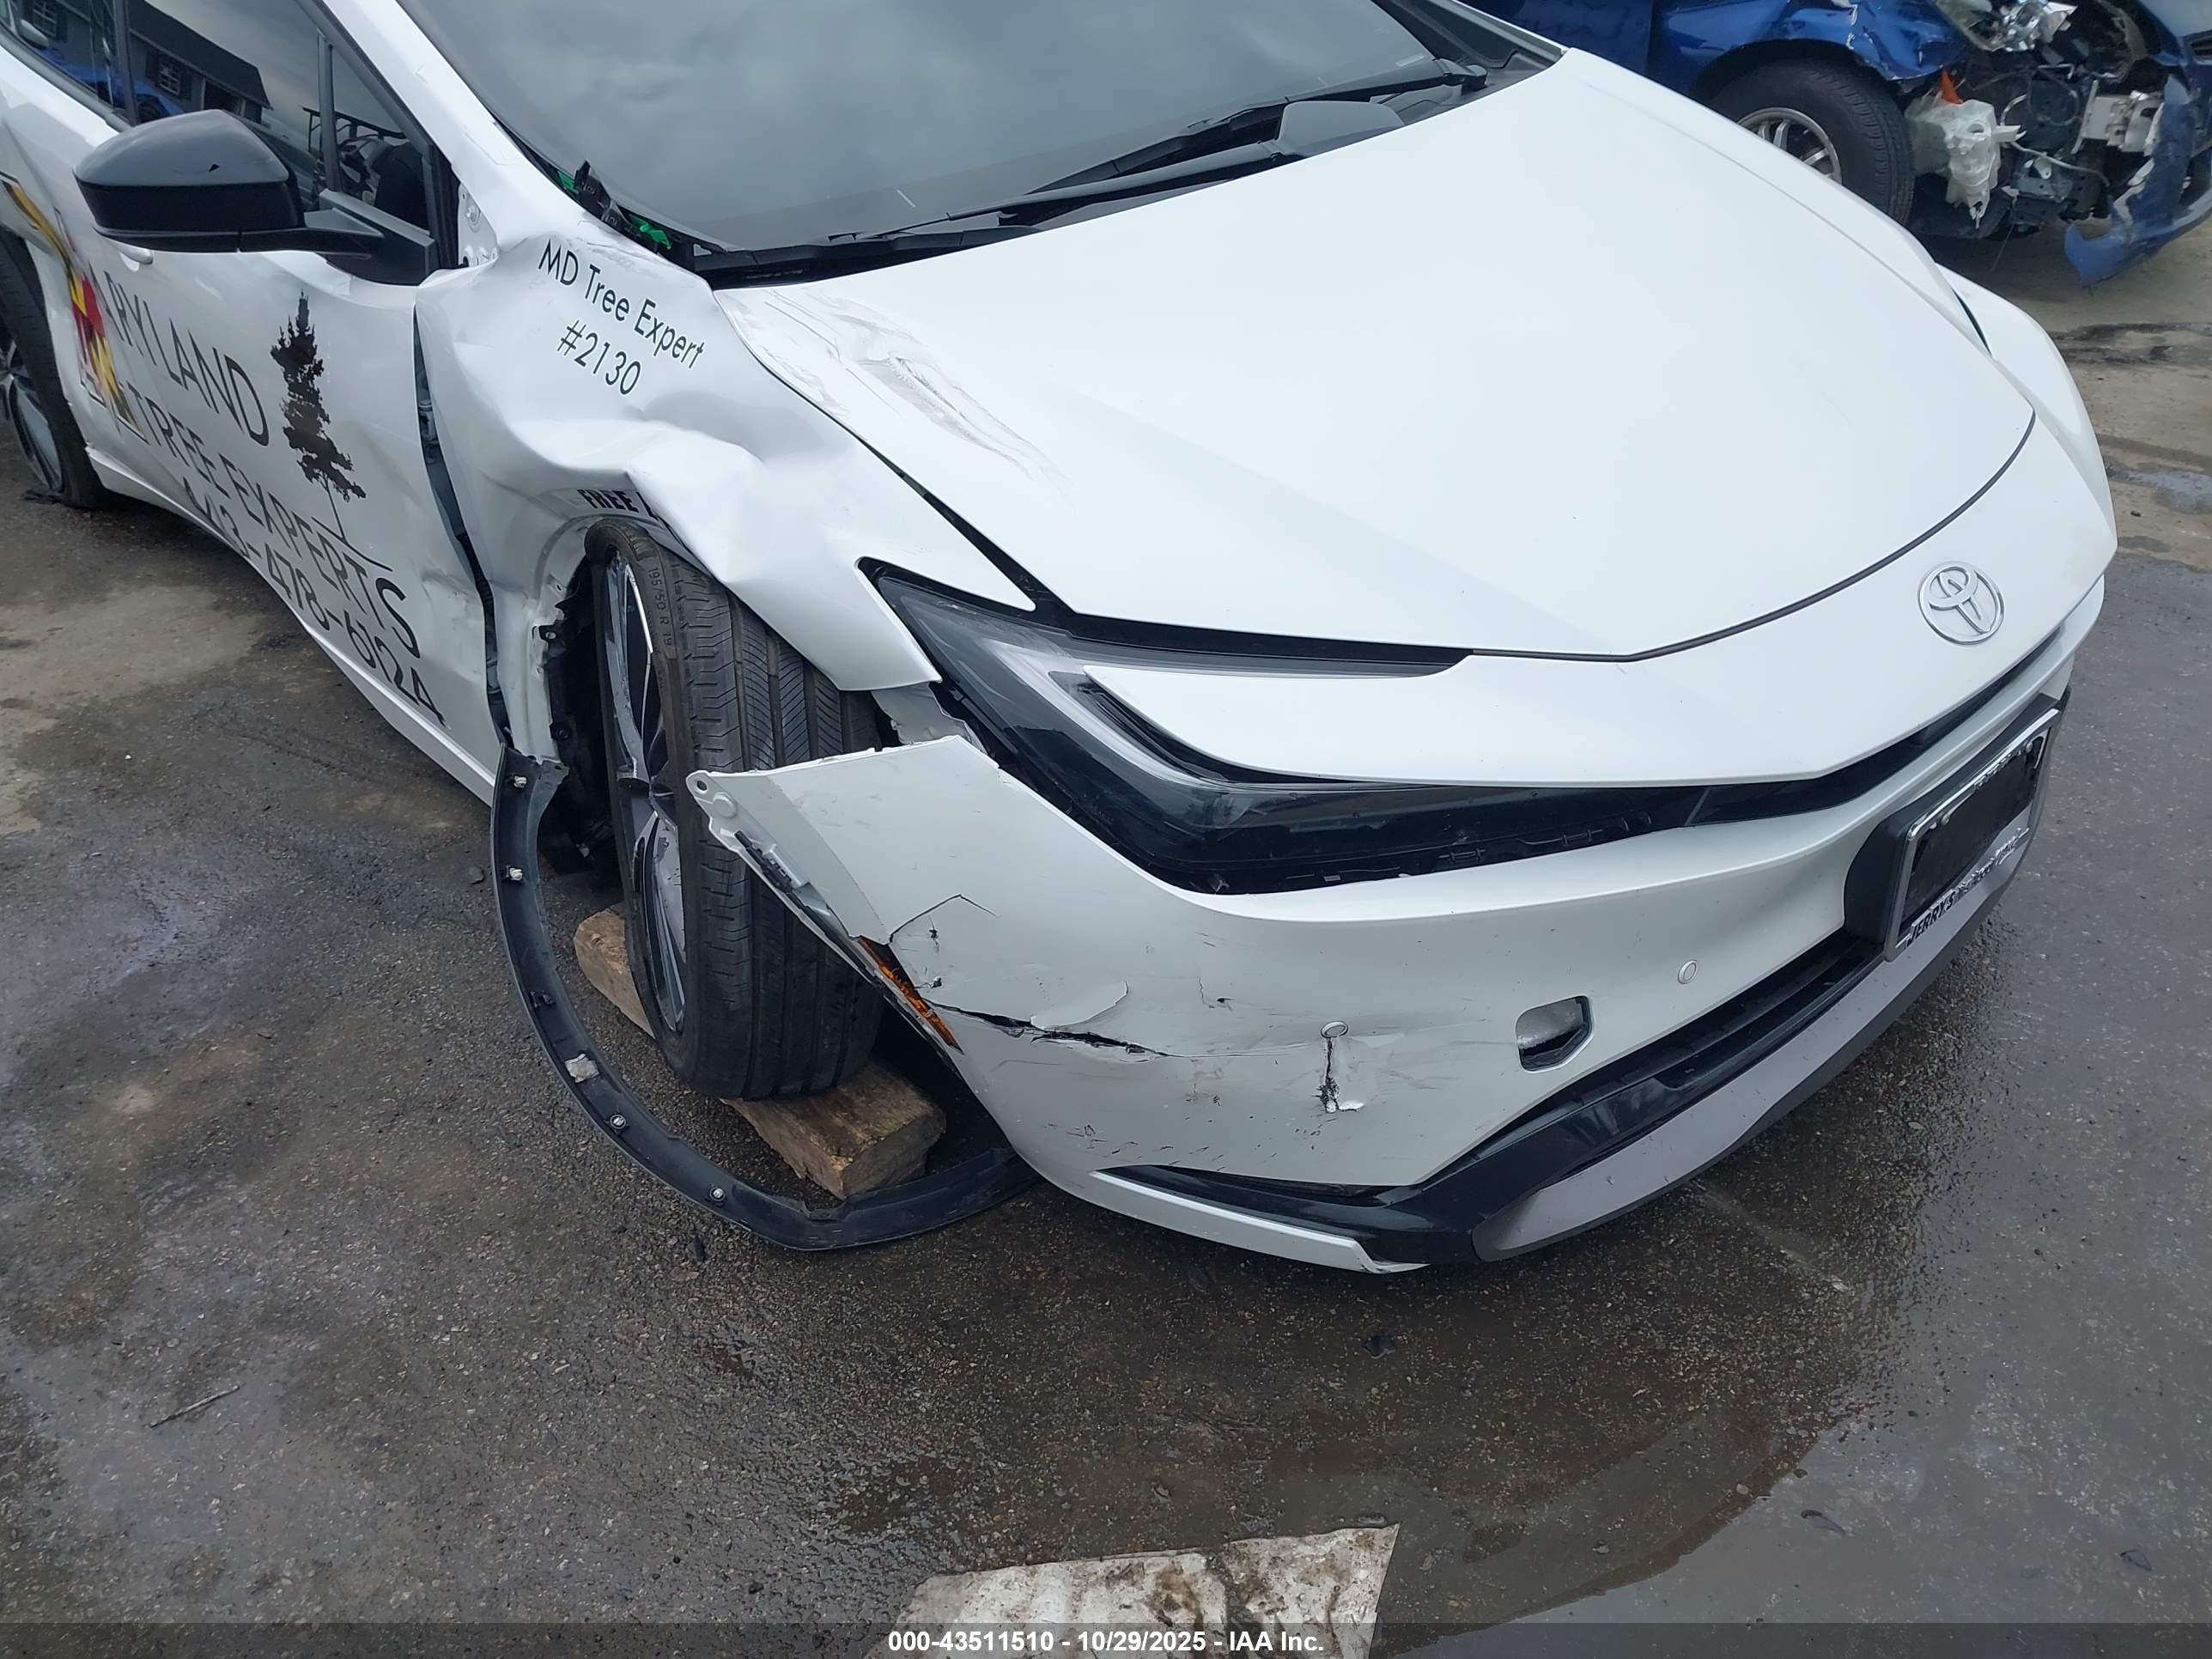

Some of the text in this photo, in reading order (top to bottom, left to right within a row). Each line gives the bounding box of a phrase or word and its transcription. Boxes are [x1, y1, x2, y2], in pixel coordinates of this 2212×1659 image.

[538, 238, 705, 369] MD Tree Expert
[557, 319, 641, 395] #2130
[125, 380, 421, 659] TREE EXPERTS
[577, 489, 640, 513] FREE
[647, 567, 667, 612] 195/50
[659, 616, 670, 626] R
[661, 632, 674, 647] 19
